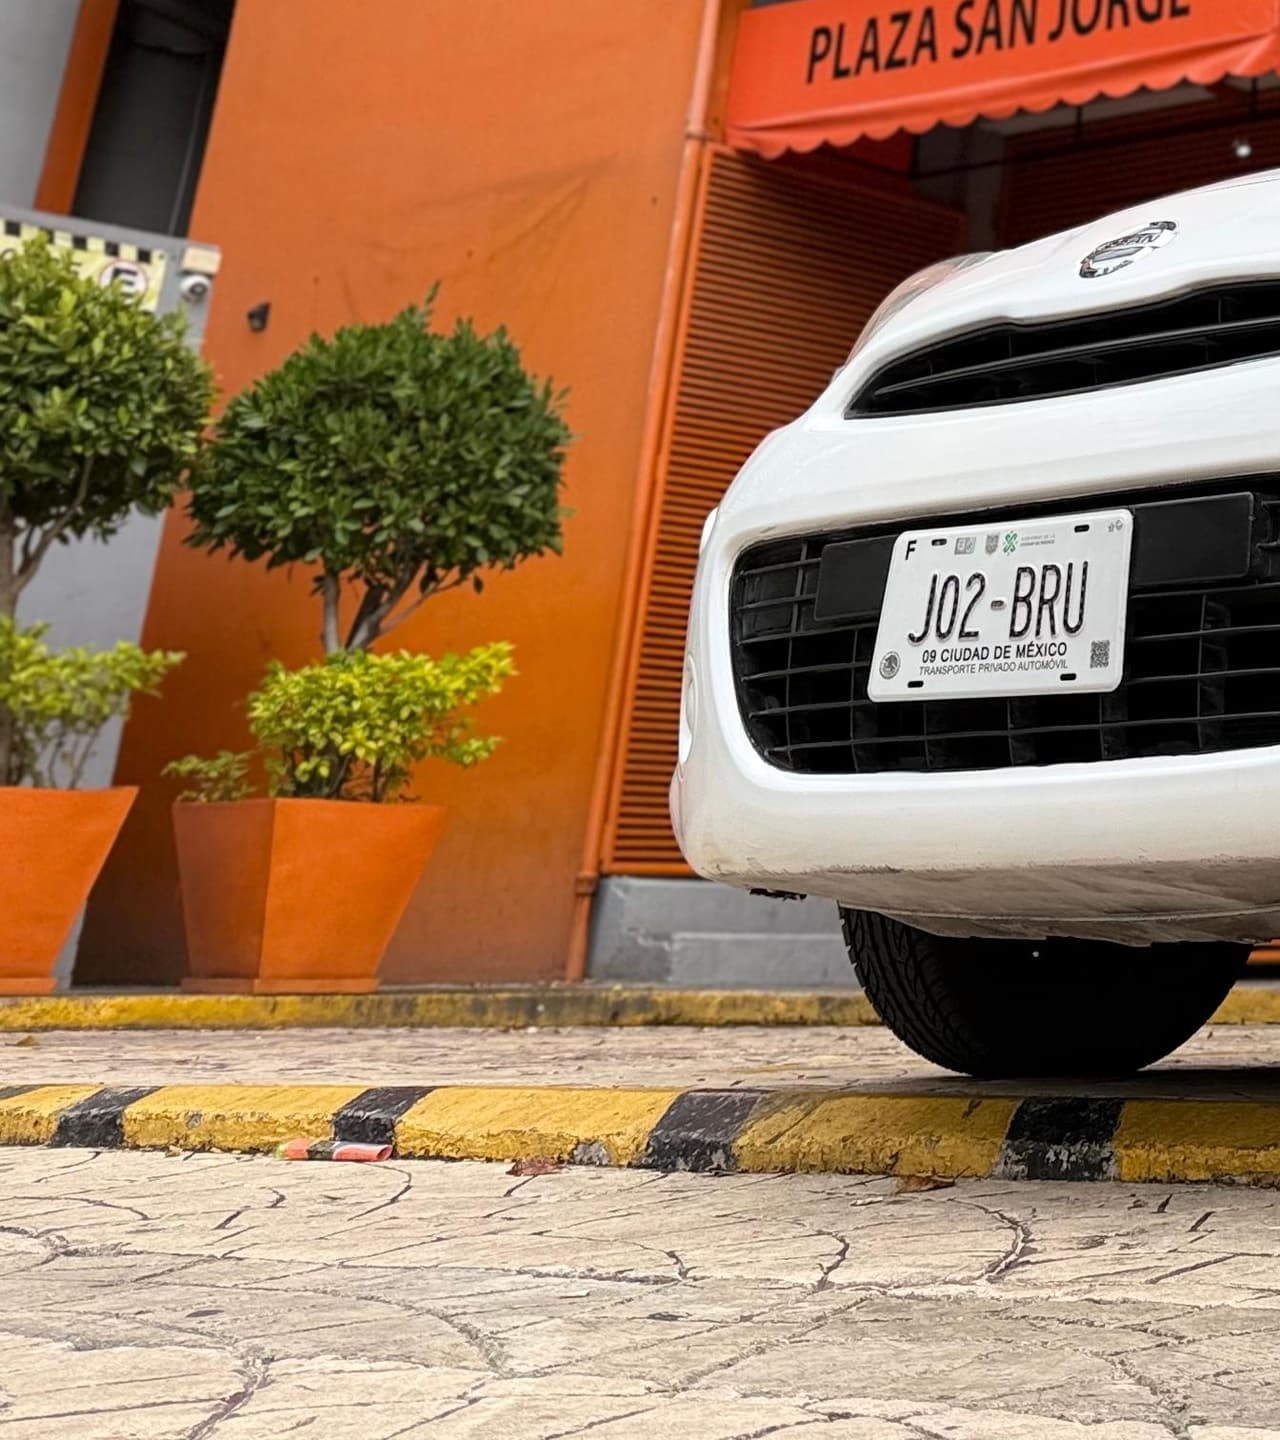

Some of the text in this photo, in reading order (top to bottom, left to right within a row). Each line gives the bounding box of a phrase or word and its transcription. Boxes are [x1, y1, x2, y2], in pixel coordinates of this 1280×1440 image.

[805, 10, 938, 85] PLAZA
[905, 540, 917, 560] F
[923, 641, 1067, 664] 09 CIUDAD DE MÉXICO
[919, 658, 1068, 676] TRANSPORTE PRIVADO AUTOMÓVIL
